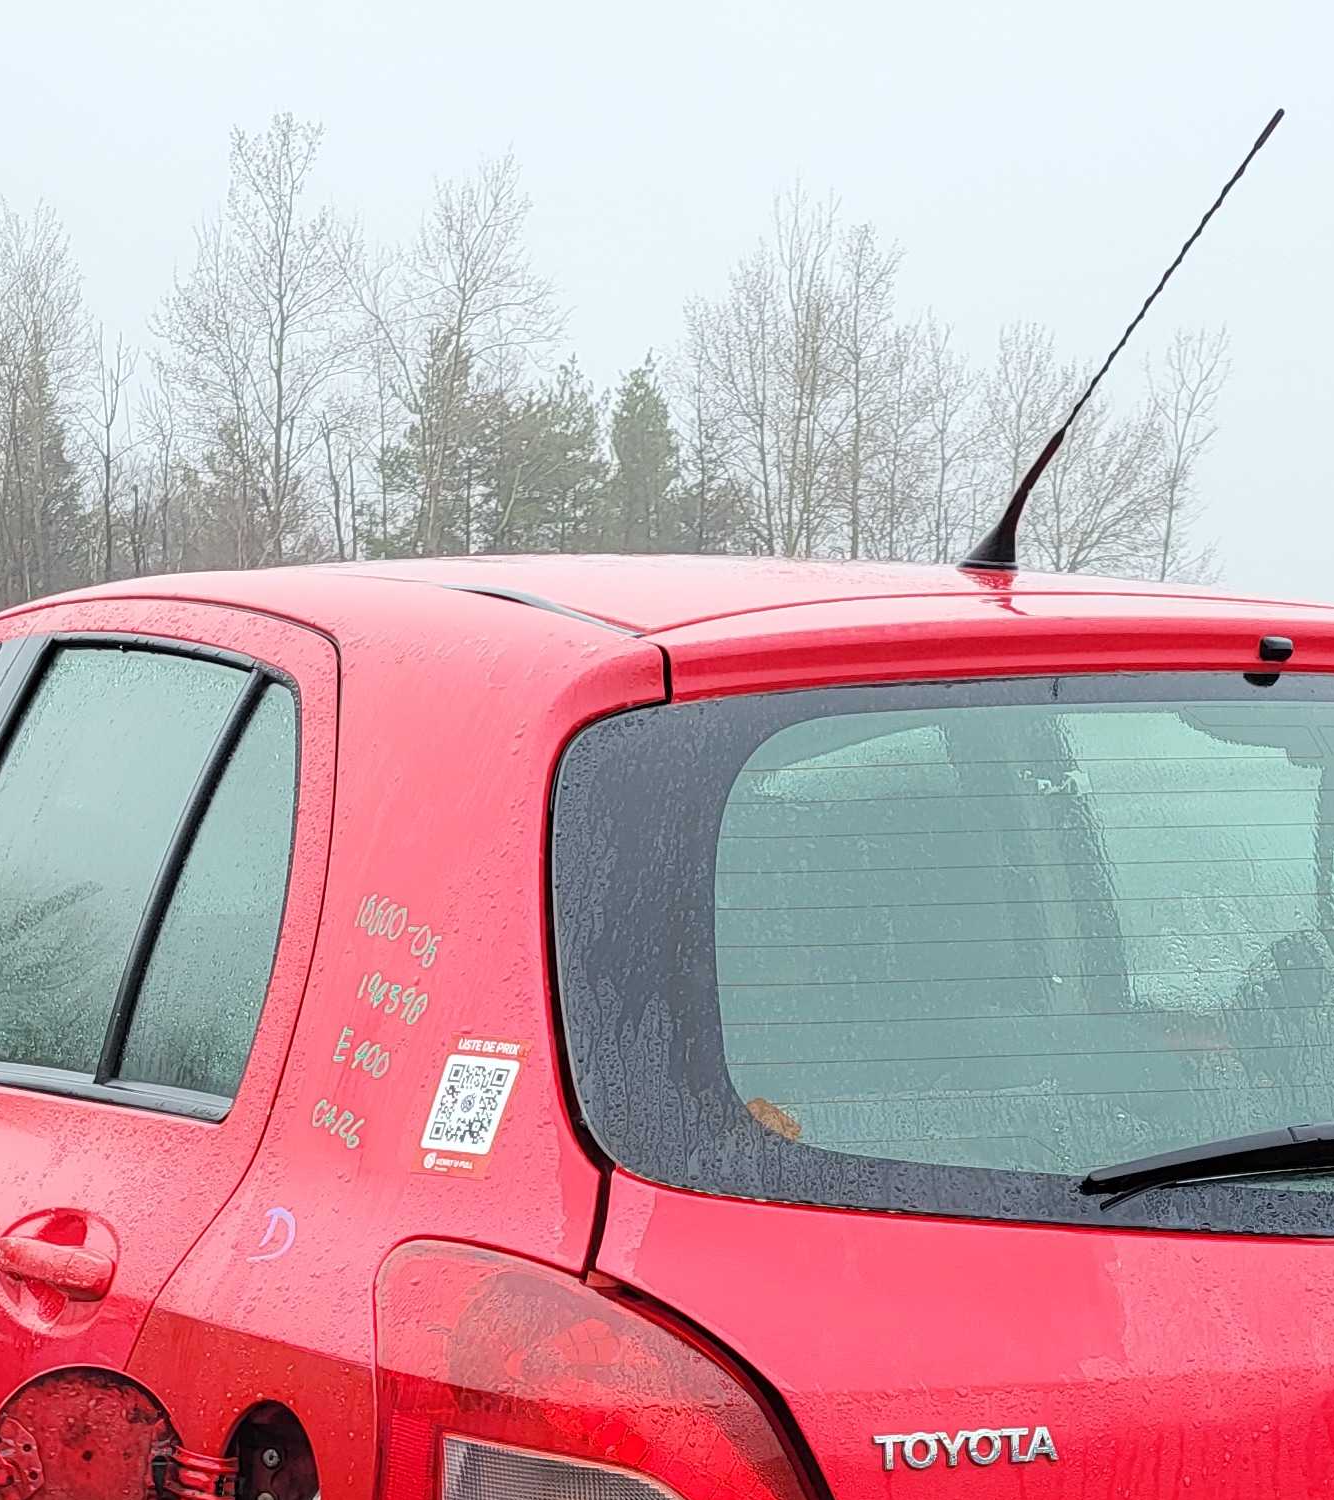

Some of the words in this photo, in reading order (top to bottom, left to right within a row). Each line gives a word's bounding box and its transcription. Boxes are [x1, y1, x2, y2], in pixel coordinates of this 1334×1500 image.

[332, 1026, 355, 1062] E
[458, 1037, 483, 1051] LISTE
[482, 1040, 497, 1053] DE
[496, 1042, 521, 1056] PRIX
[873, 1426, 1059, 1470] TOYOTA
